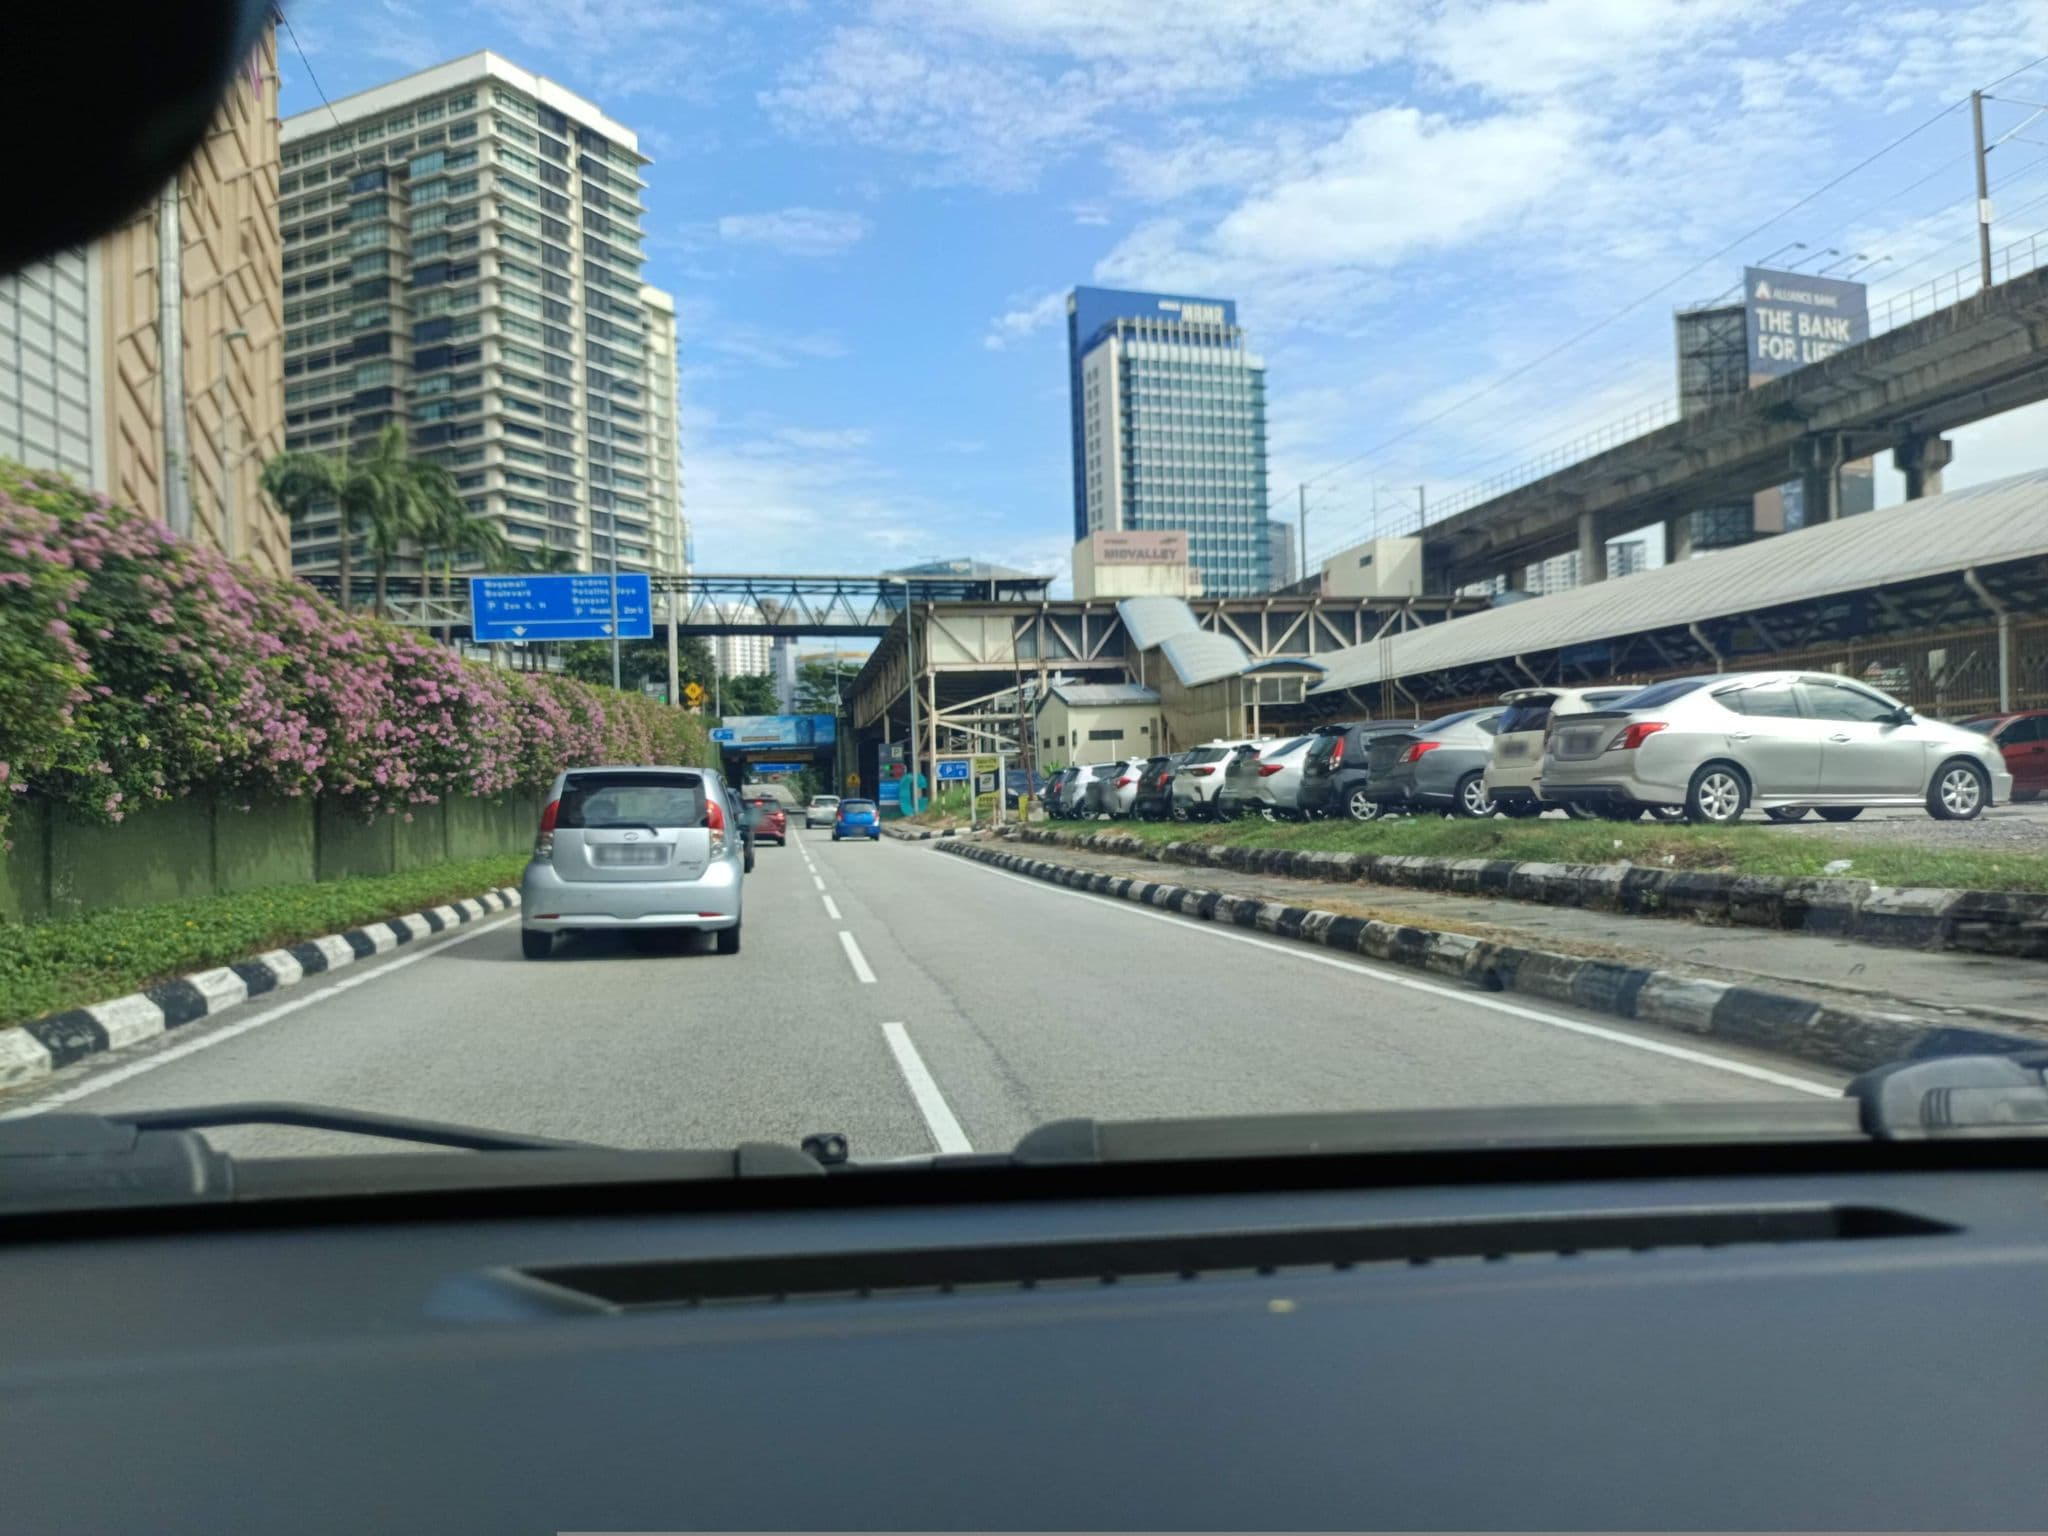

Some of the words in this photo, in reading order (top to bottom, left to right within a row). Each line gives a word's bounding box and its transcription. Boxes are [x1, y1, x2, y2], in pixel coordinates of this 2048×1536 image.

[1755, 308, 1793, 334] THE
[1798, 312, 1851, 342] BANK
[1758, 334, 1797, 362] FOR
